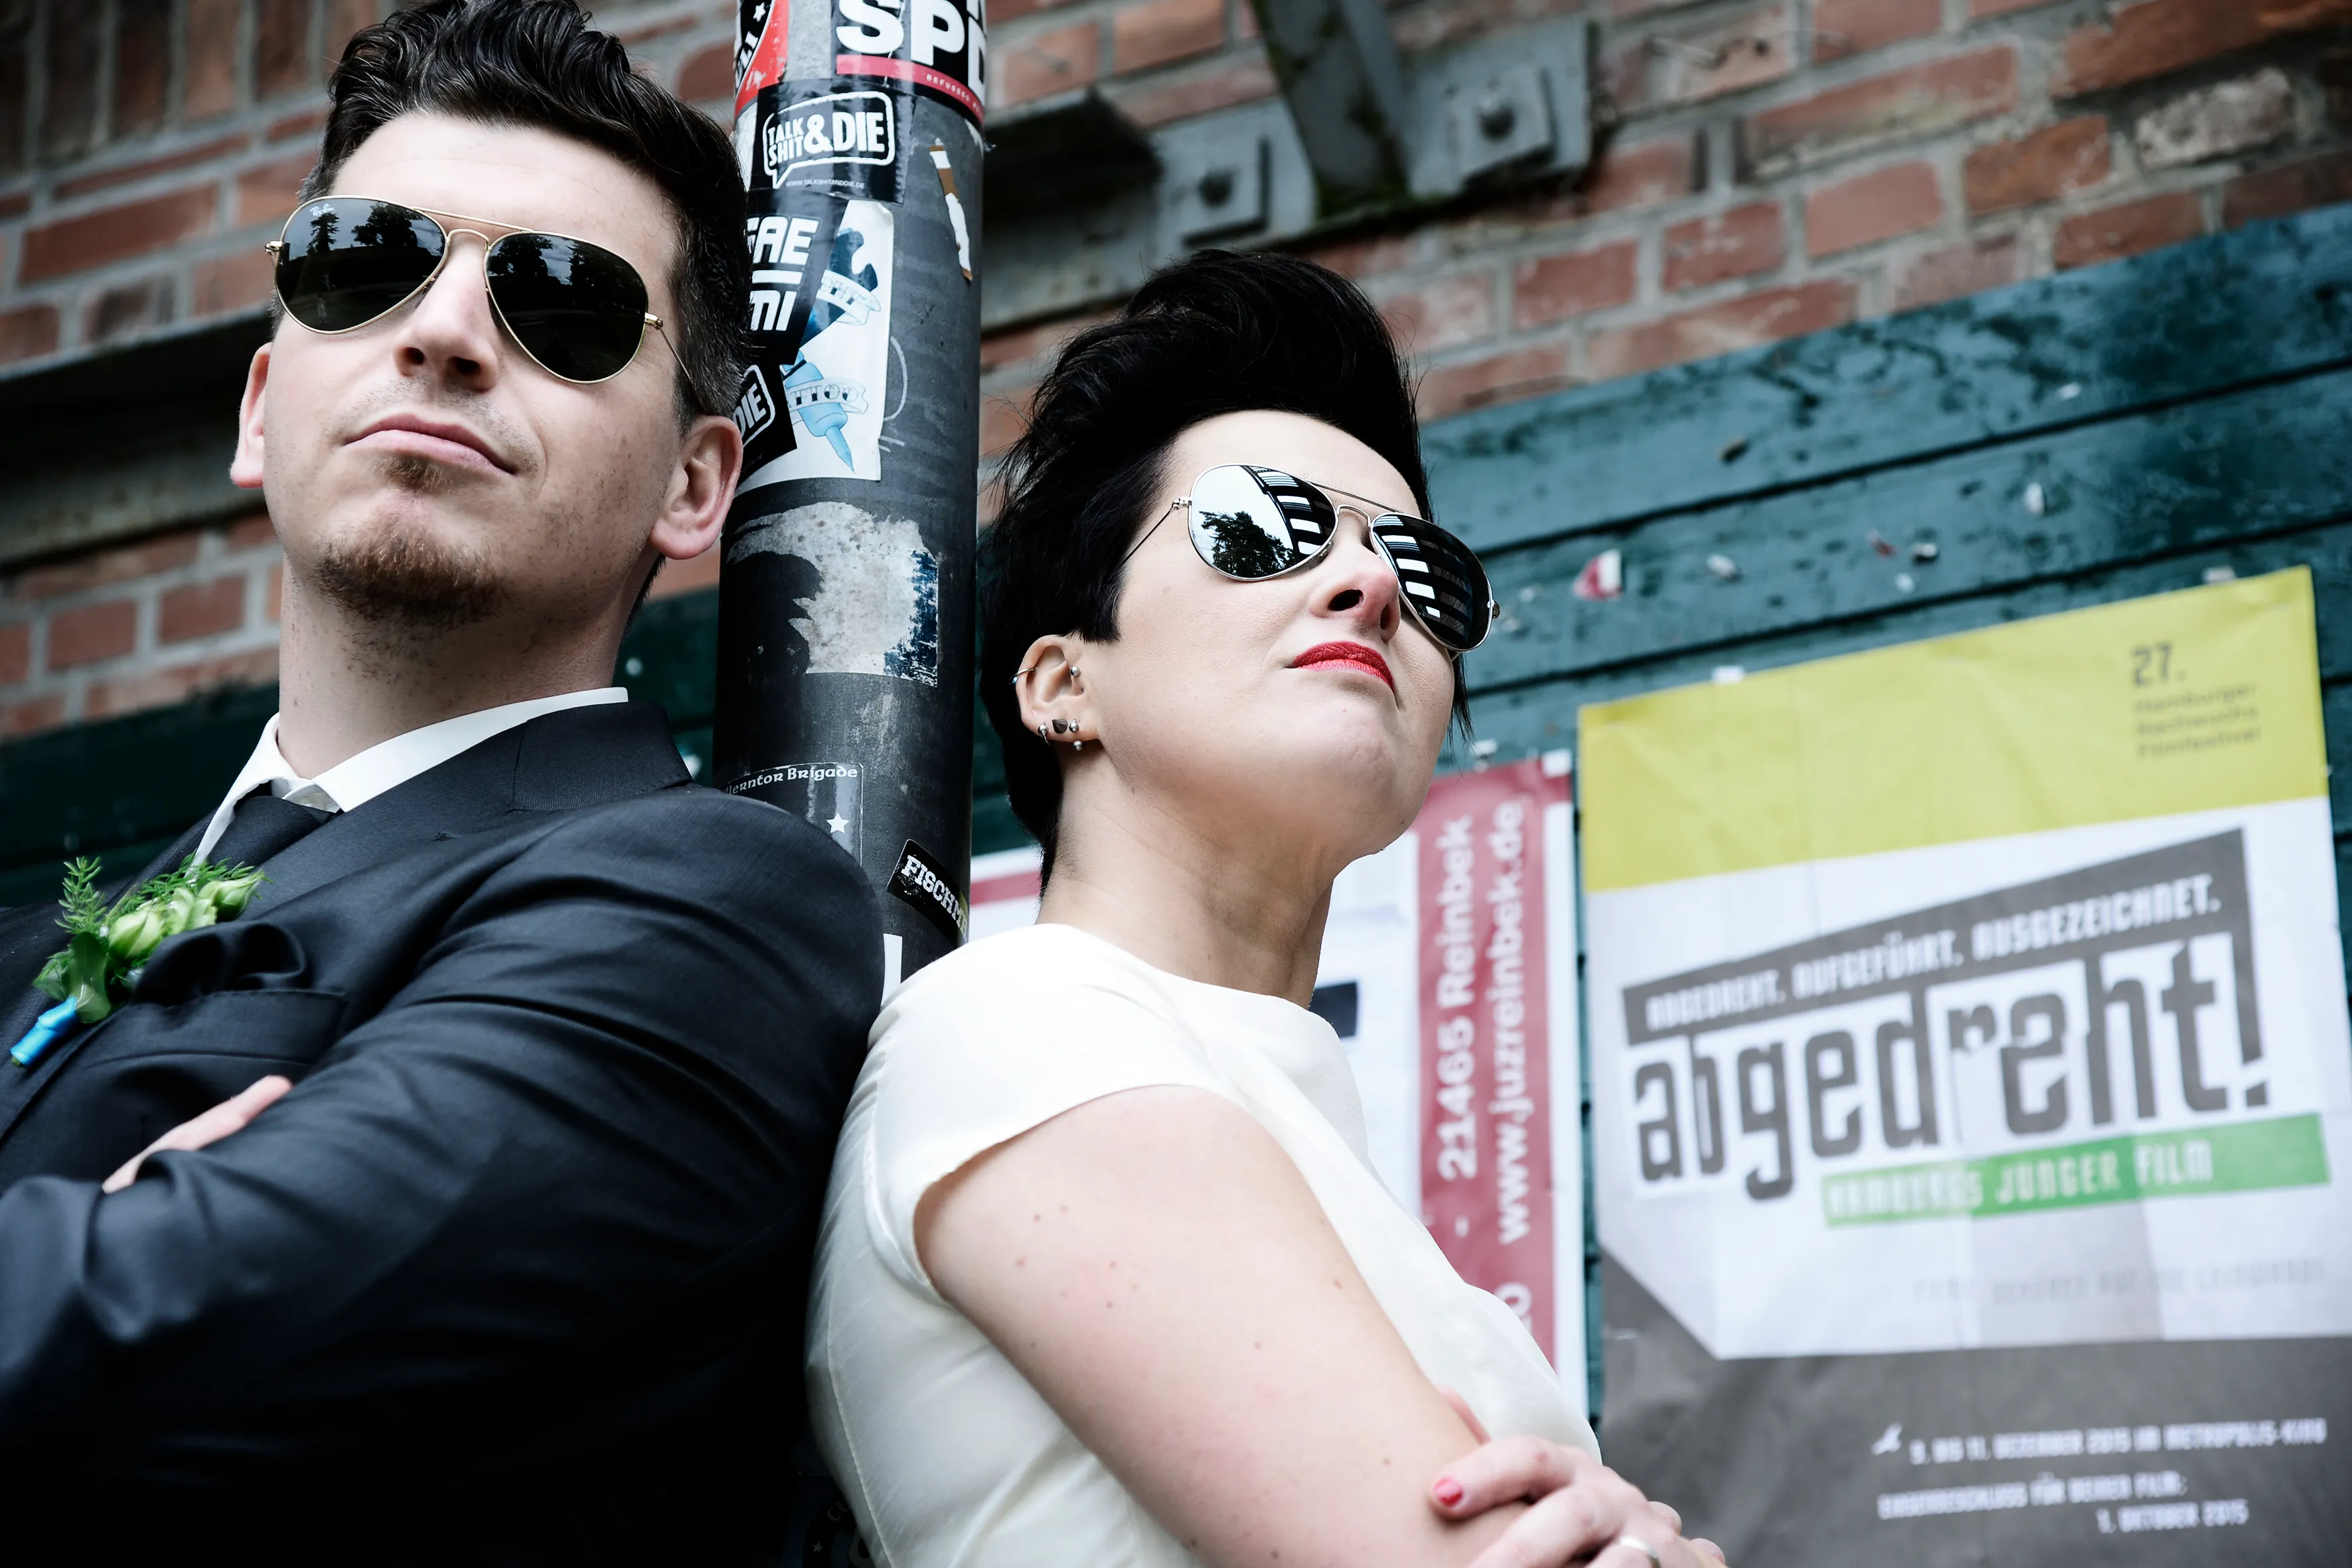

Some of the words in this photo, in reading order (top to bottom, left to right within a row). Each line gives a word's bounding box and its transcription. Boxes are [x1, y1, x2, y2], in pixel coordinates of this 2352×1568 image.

[767, 117, 804, 146] TALK
[768, 135, 805, 167] SHIT
[832, 111, 885, 152] DIE
[785, 179, 865, 189] WWW.TALKSHITANDDIE.DE
[787, 384, 859, 408] TTOO
[2132, 641, 2187, 686] 27.
[787, 765, 858, 781] Brigade
[1435, 813, 1476, 1008] Reinbek
[1971, 873, 2221, 961] AUSGEZEICHNET.
[1485, 801, 1535, 1246] www.juzreinbek.de
[1634, 933, 2268, 1200] abgedreht!
[1436, 1014, 1478, 1182] 21465
[1995, 1150, 2122, 1205] JUNGER
[2133, 1138, 2213, 1187] FILM
